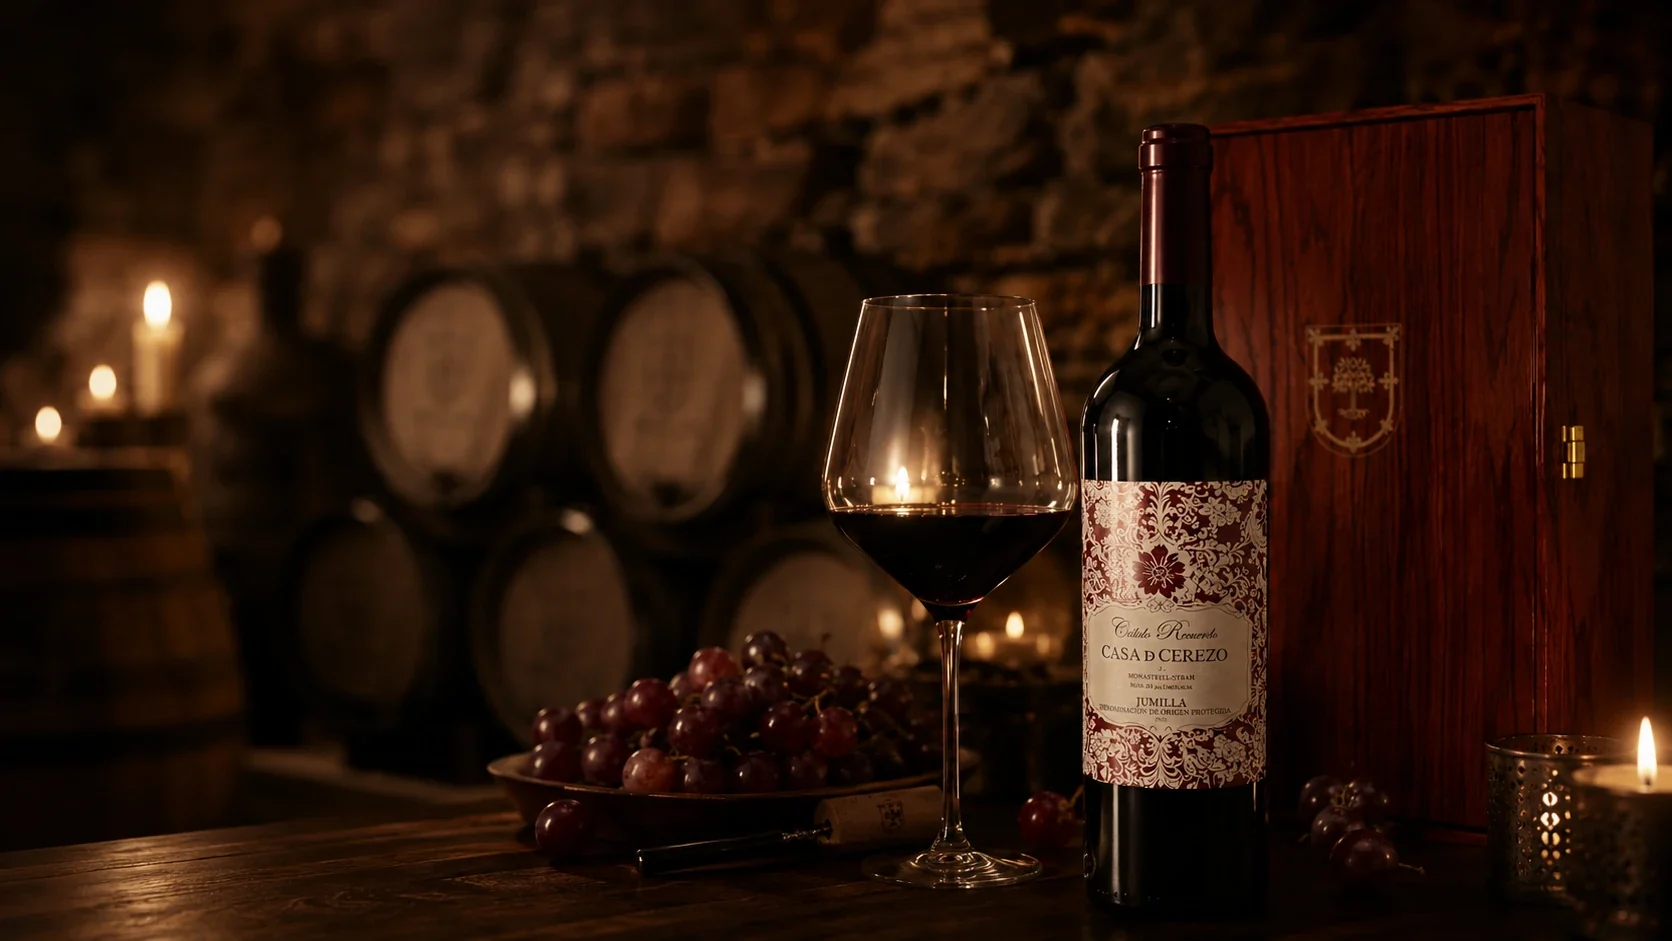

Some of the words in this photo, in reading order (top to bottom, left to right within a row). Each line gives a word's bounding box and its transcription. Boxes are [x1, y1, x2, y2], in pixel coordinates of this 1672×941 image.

[1101, 645, 1141, 662] CASA
[1158, 648, 1228, 662] CEREZO
[1136, 697, 1187, 708] JUMILLA
[1160, 708, 1189, 716] ORIGEN
